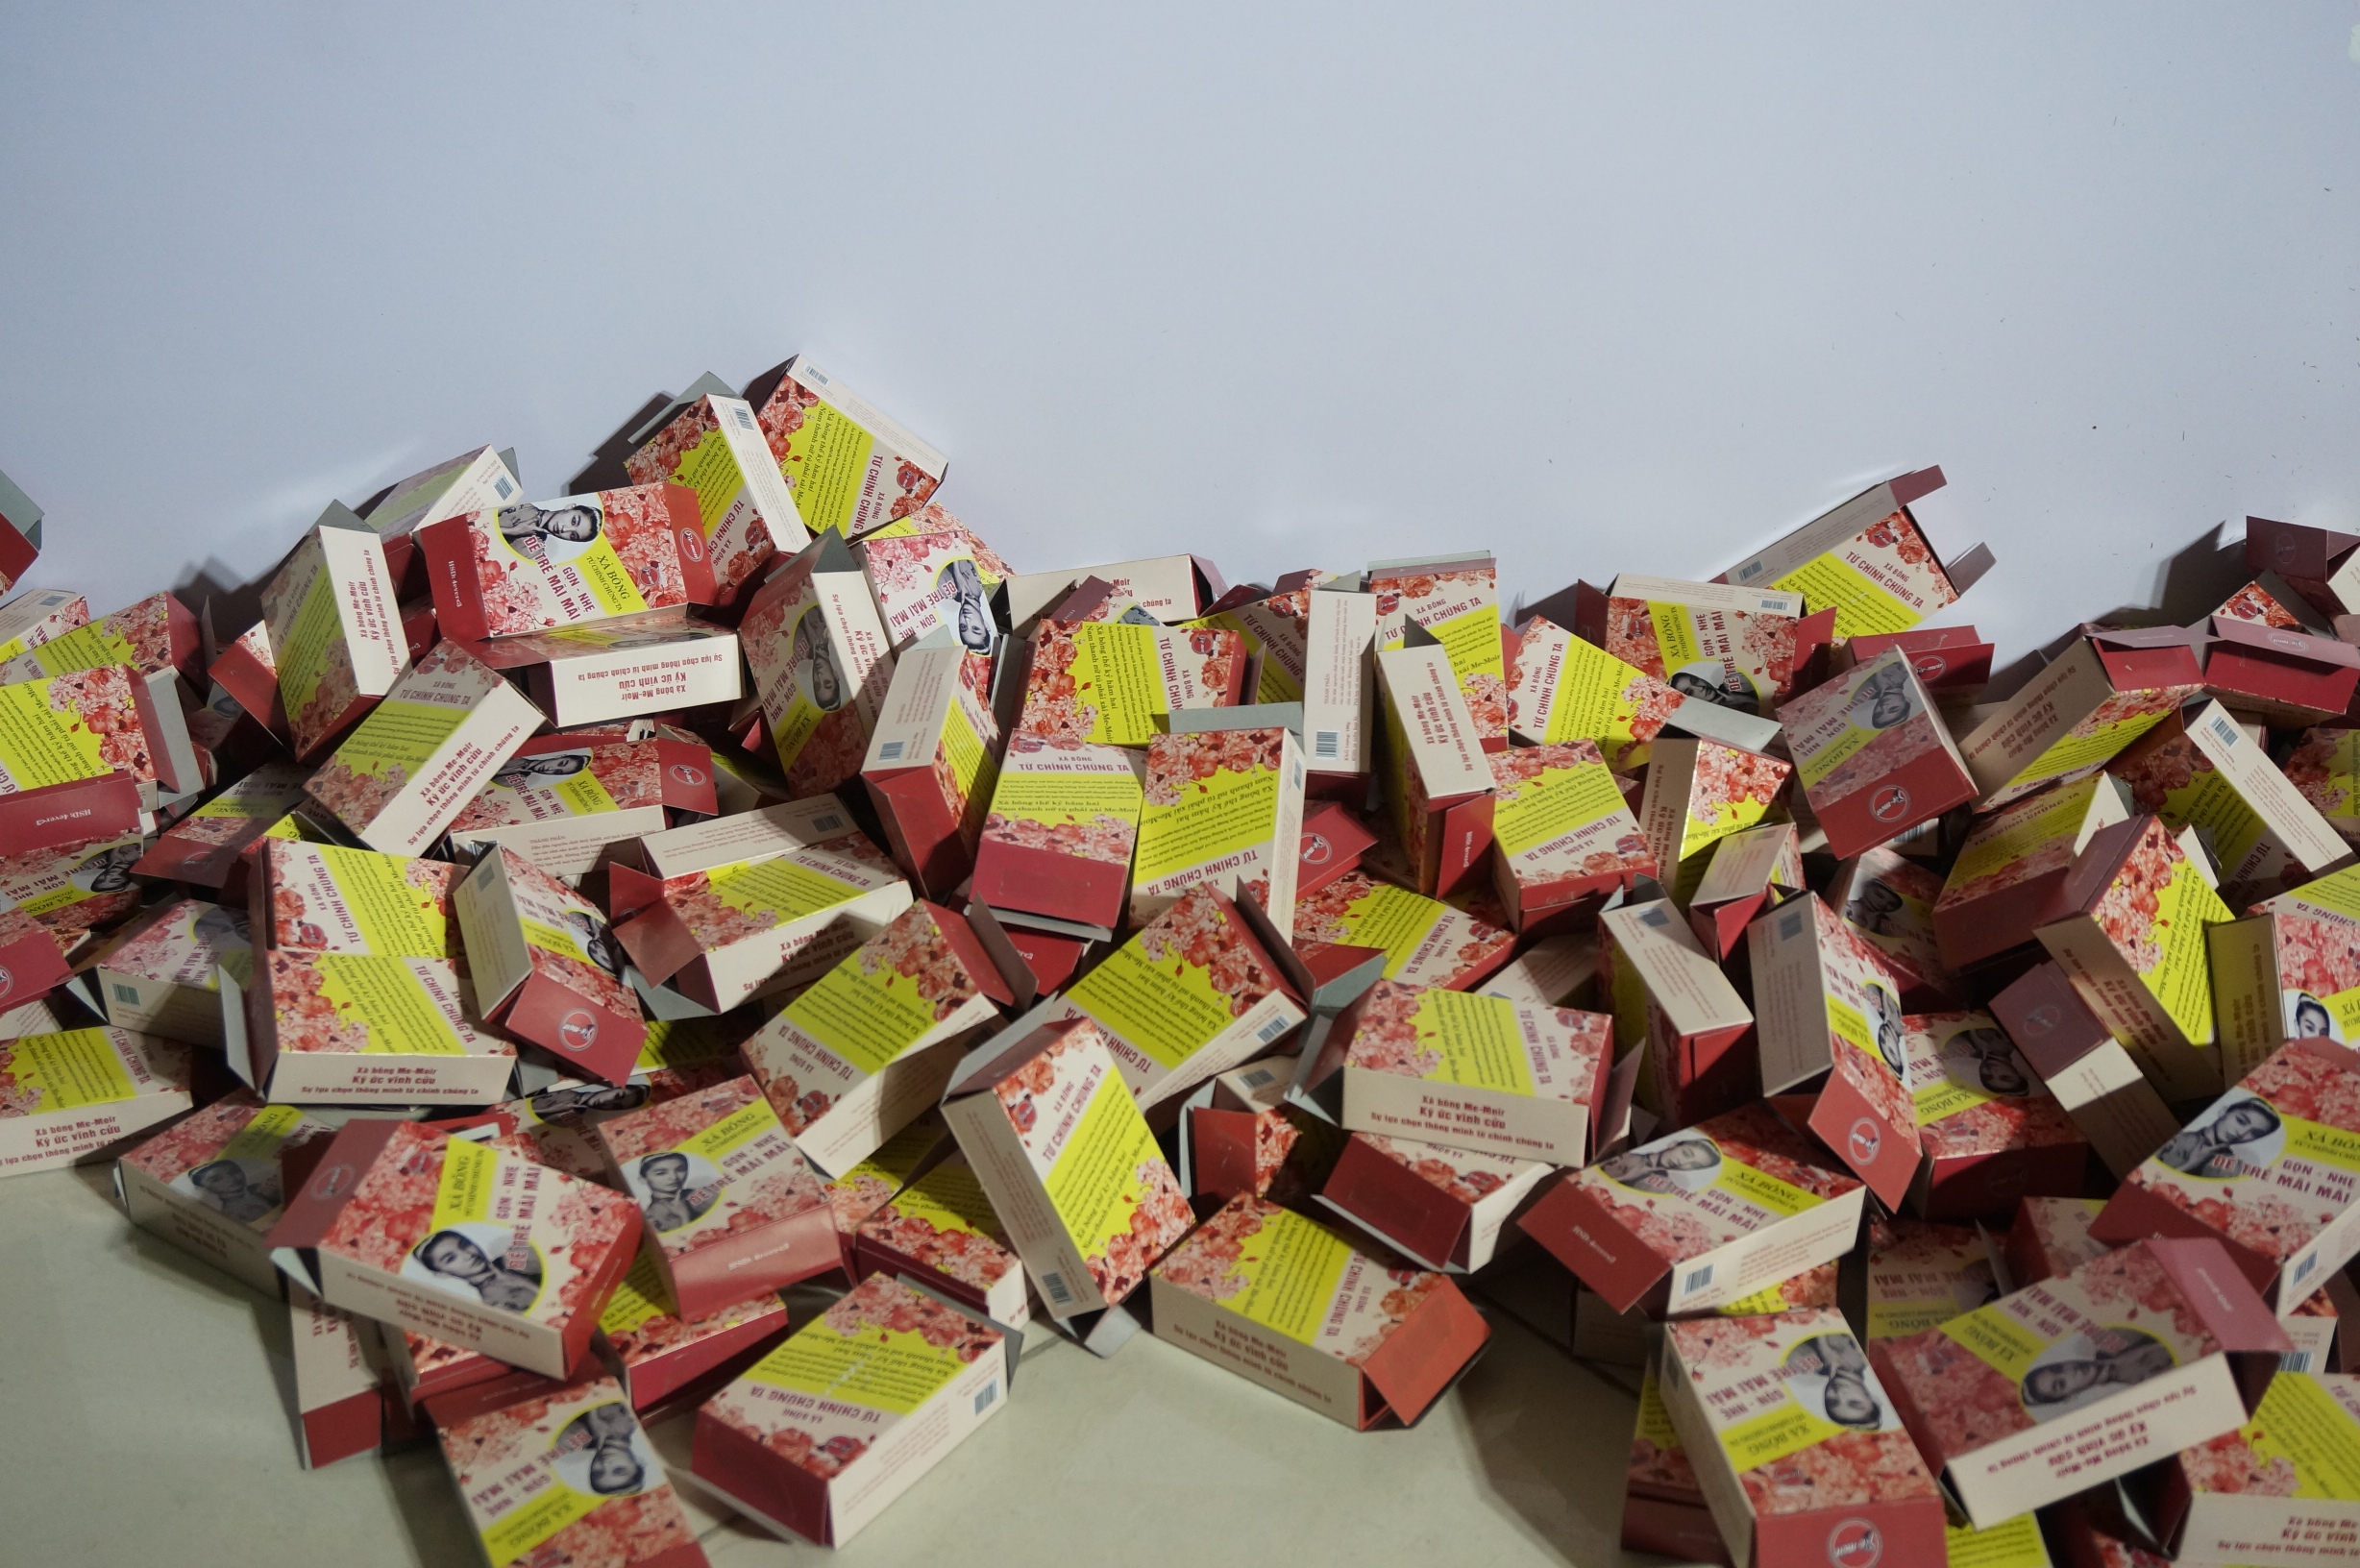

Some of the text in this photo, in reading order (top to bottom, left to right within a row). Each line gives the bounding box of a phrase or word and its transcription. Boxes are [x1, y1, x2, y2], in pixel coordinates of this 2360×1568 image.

[871, 455, 883, 468] TỪ
[864, 468, 879, 498] CHÍNH
[715, 500, 745, 542] TỪ CHÍNH
[853, 499, 871, 529] CHÚNG
[535, 552, 553, 574] TRẺ
[547, 574, 567, 597] MÃI
[560, 597, 580, 621] MÃI
[561, 566, 580, 587] GỌN
[578, 592, 596, 613] NHẸ
[1845, 551, 1925, 609] TỪ CHÍNH CHÚNG TA
[925, 589, 945, 605] TRẺ
[889, 610, 911, 625] MÃI
[908, 600, 929, 616] MÃI
[919, 613, 937, 629] GỌN
[1385, 627, 1398, 641] TỪ
[1433, 601, 1468, 622] CHÚNG
[1468, 597, 1483, 607] TA
[1695, 613, 1709, 631] NHẸ
[1709, 610, 1725, 632] MÃI
[1701, 638, 1716, 657] GỌN
[1716, 633, 1732, 655] MÃI
[660, 659, 681, 670] thông
[681, 657, 700, 666] chọn
[700, 655, 712, 664] lựa
[713, 653, 723, 662] Sự
[1721, 657, 1735, 675] TRẺ
[578, 674, 586, 682] ta
[586, 670, 609, 680] chúng
[610, 667, 631, 677] chính
[641, 663, 659, 674] minh
[1159, 636, 1184, 711] TỪ CHÍNH CHÚN
[618, 671, 687, 690] Ký ức vĩnh cửu
[1183, 679, 1194, 699] BÔNG
[1533, 643, 1564, 729] TỪ CHÍNH CHÚNG TA
[621, 689, 654, 701] Me-Moir
[655, 686, 675, 696] bông
[428, 770, 448, 789] bông
[444, 742, 474, 772] Me-Moir
[426, 747, 483, 807] Ký ức vĩnh cửu
[1145, 849, 1259, 900] TỪ CHÍNH CHÚNG TA
[307, 854, 361, 944] TỪ CHÍNH CHÚNG TA
